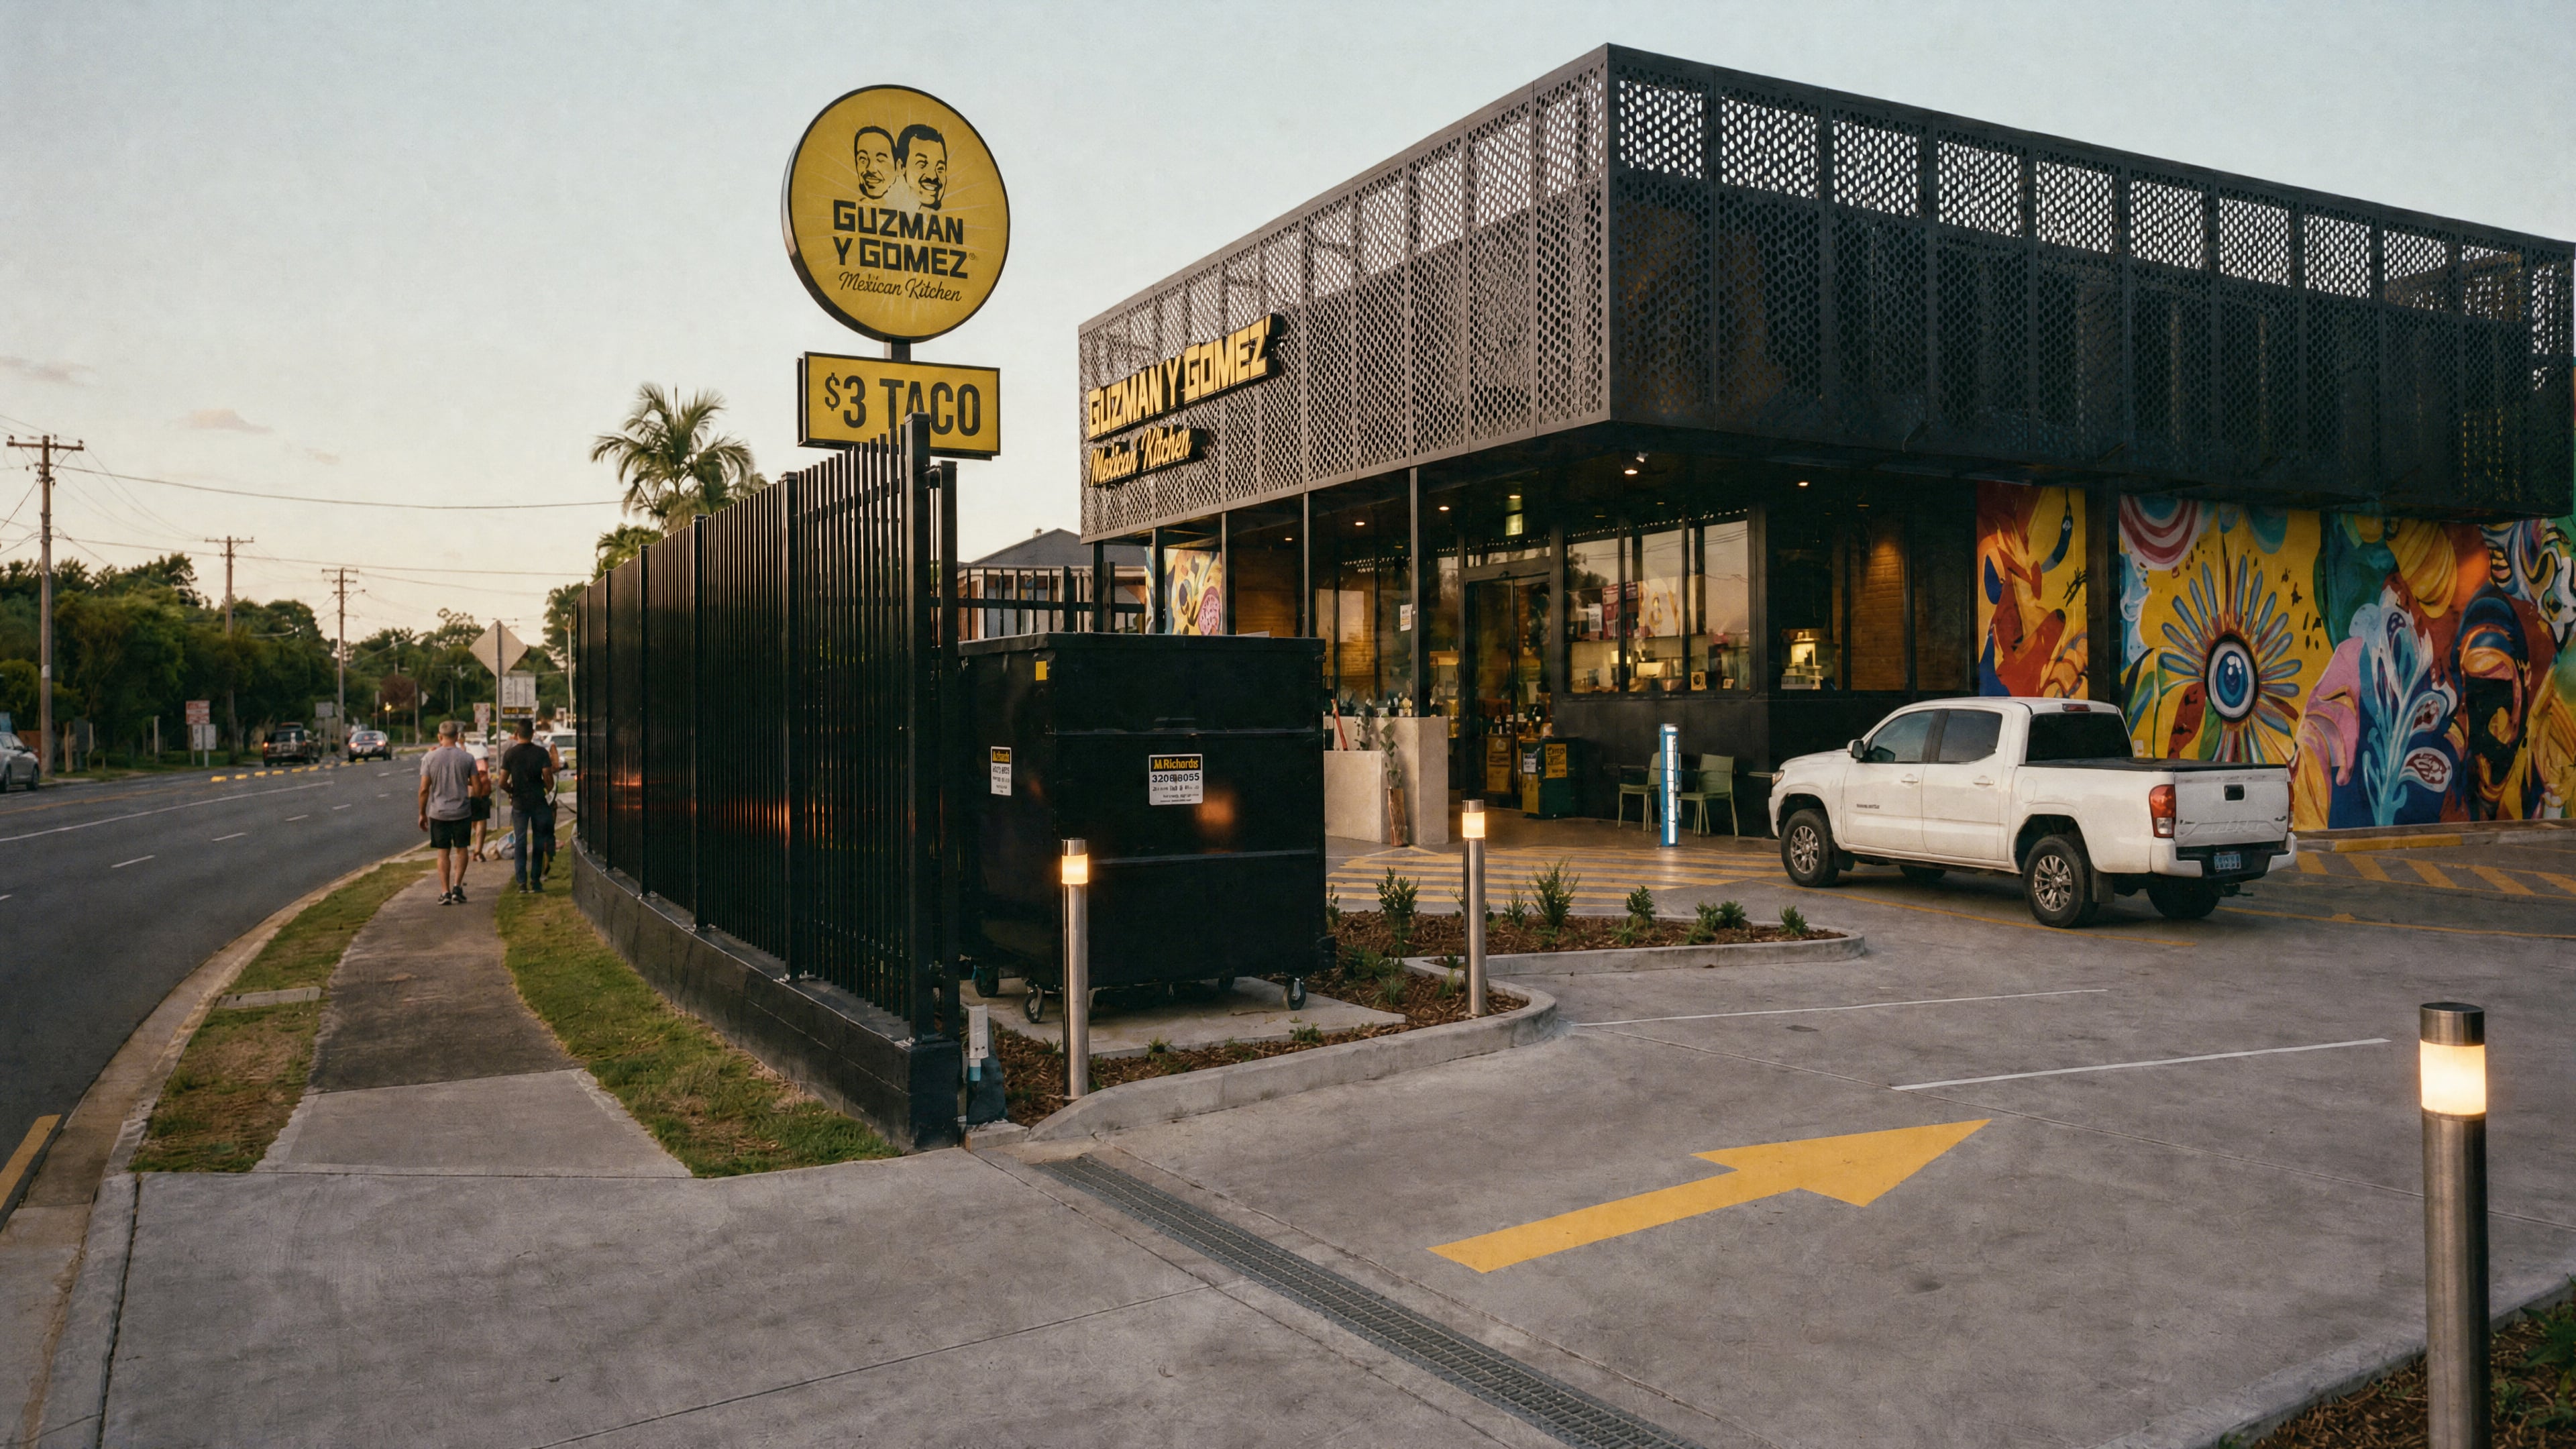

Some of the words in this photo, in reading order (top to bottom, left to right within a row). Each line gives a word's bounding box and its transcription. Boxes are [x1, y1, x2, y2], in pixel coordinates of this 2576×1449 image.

[833, 199, 963, 245] GUZMAN
[833, 236, 853, 266] Y
[859, 237, 968, 279] GOMEZ
[839, 271, 902, 296] Mexican
[905, 278, 962, 302] Kitchen
[824, 372, 867, 429] $3
[879, 378, 981, 437] TACO
[1088, 362, 1164, 439] GUZMAN
[1166, 354, 1181, 407] Y
[1089, 445, 1138, 487] Mexican
[1140, 425, 1192, 470] Kitchen
